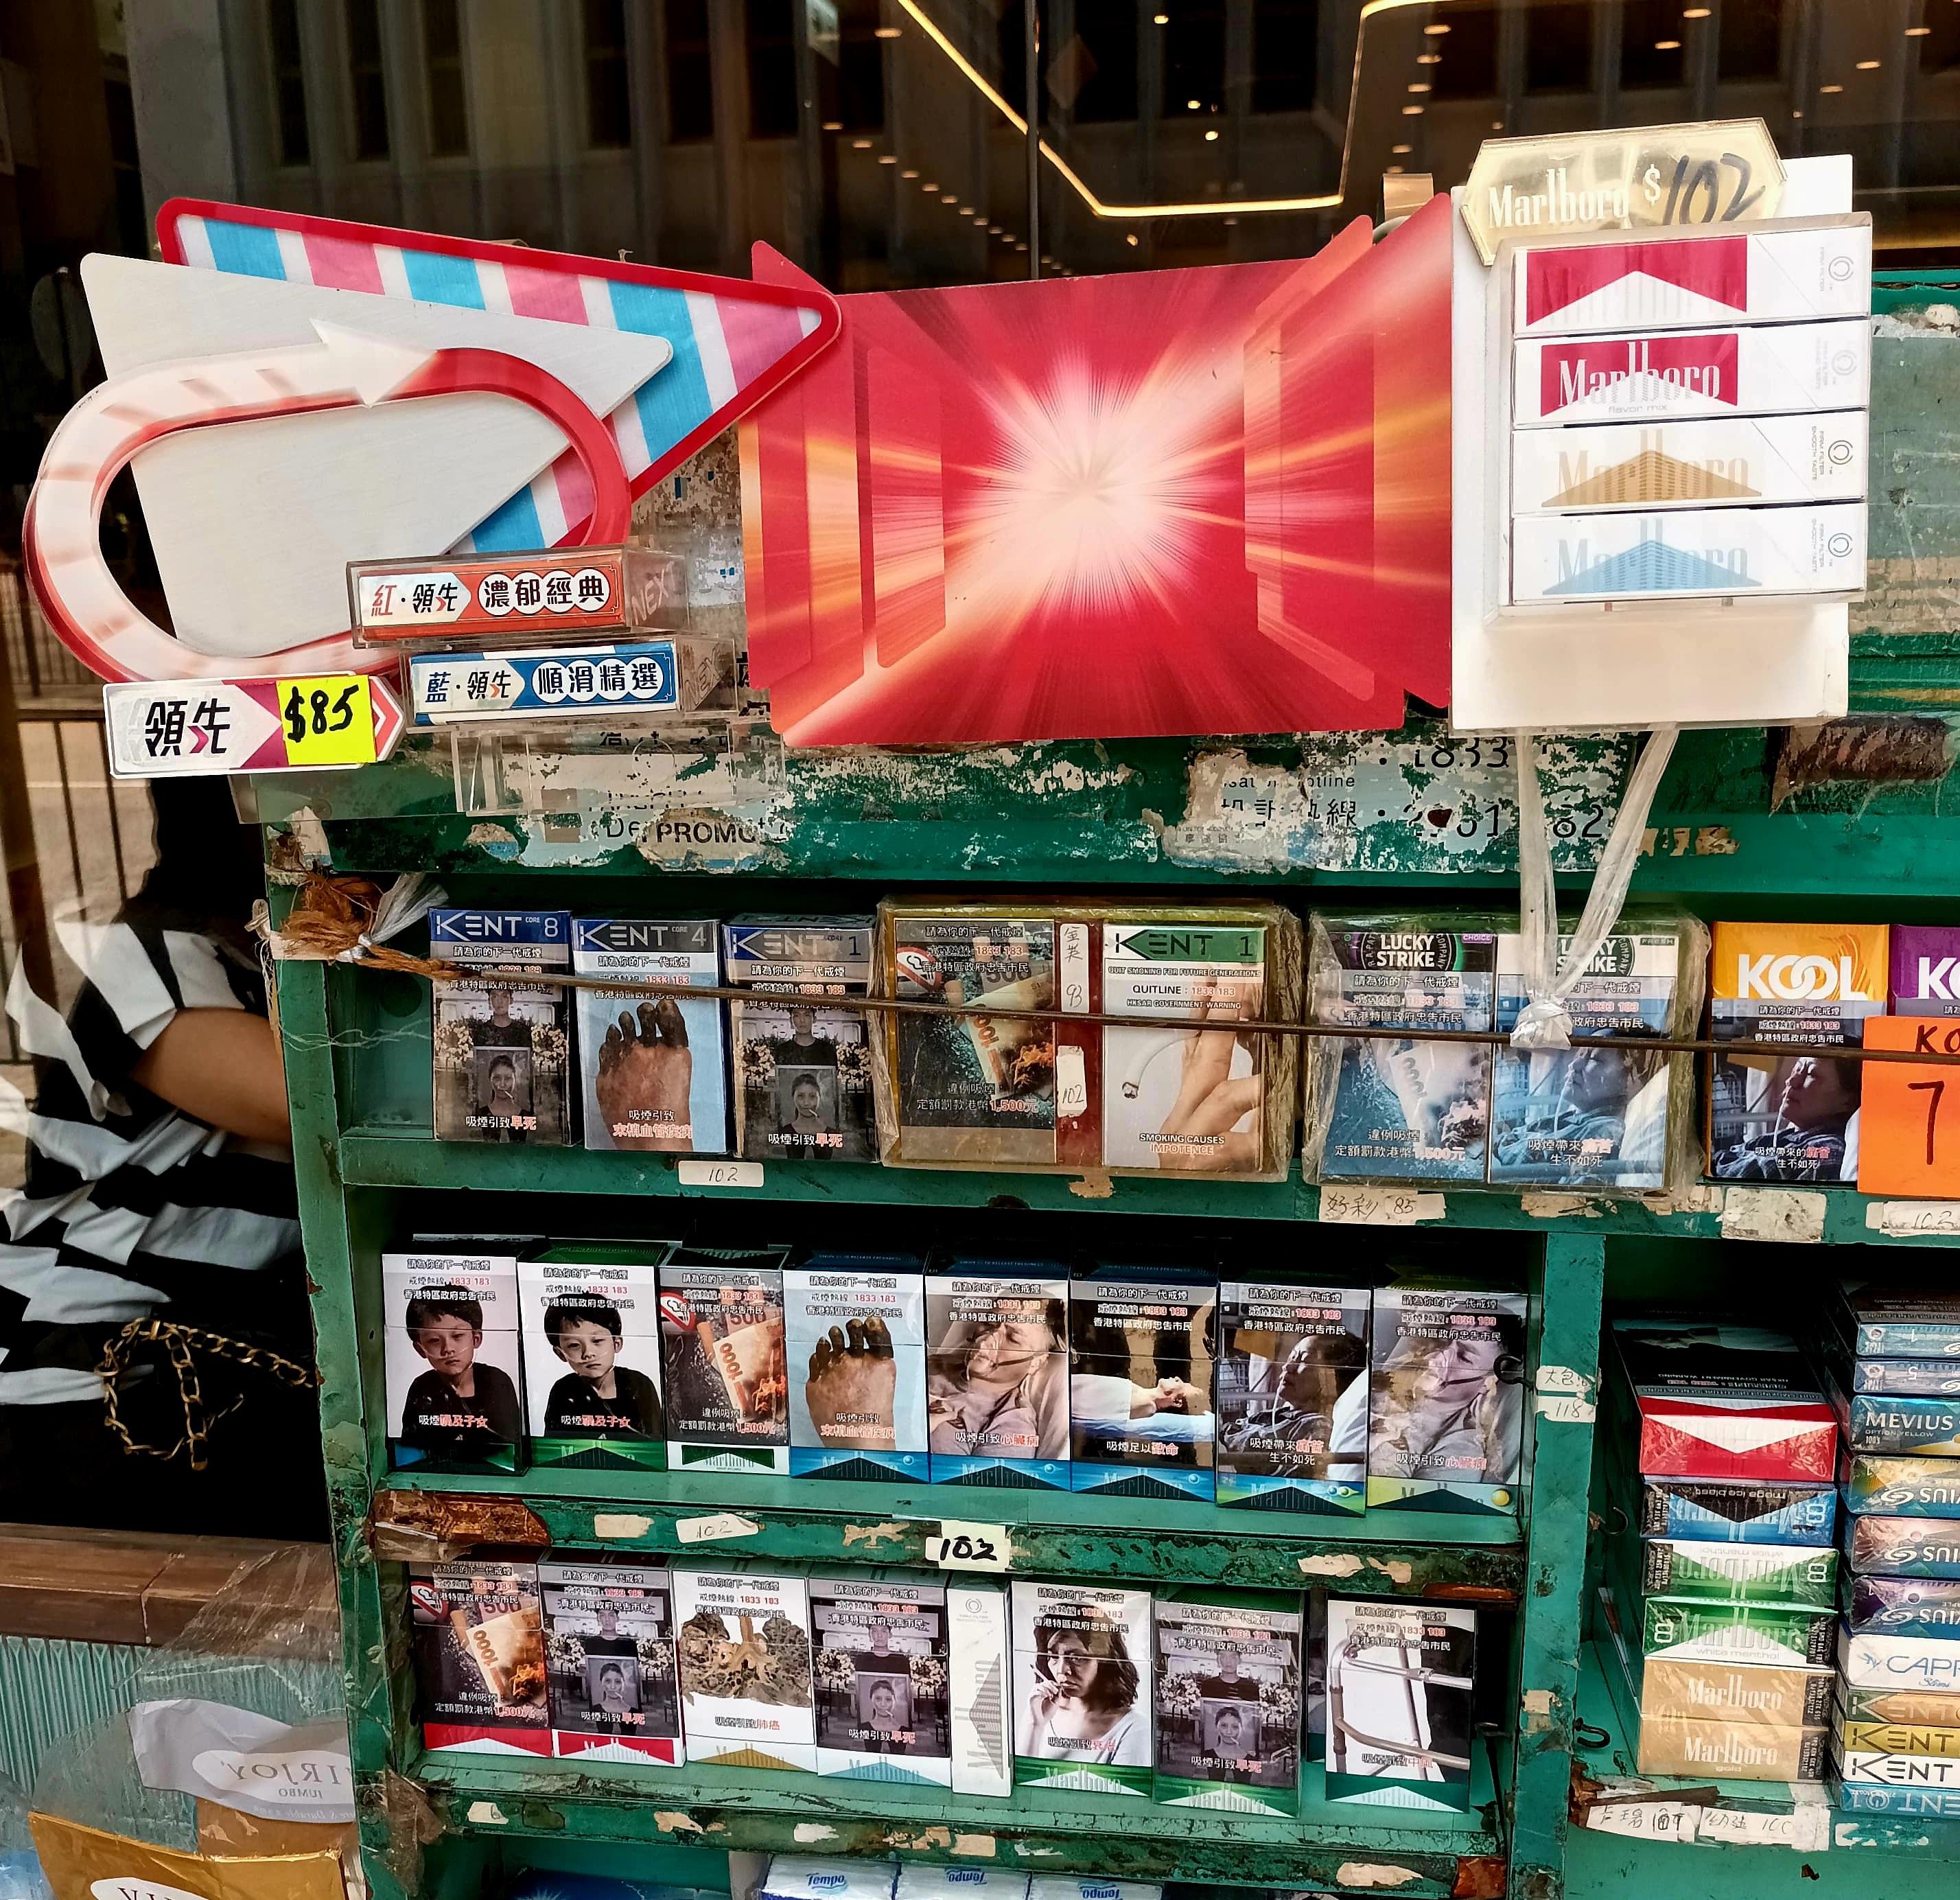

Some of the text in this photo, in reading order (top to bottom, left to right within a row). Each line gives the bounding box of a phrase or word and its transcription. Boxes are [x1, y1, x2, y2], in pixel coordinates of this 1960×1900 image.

[1489, 167, 1629, 229] Marlboro
[1559, 341, 1721, 406] Marlboro
[1644, 402, 1668, 412] mix
[483, 574, 607, 607] 濃郁經典
[537, 656, 660, 694] 順滑精選
[284, 685, 359, 743] $85
[144, 697, 231, 757] 領先
[436, 912, 522, 942] KENT
[544, 917, 559, 938] 8
[925, 925, 1024, 938] 請為你的下一代戒煙
[580, 923, 668, 951] KENT
[691, 927, 707, 946] 4
[1380, 934, 1434, 951] LUCKY
[1462, 934, 1492, 942] CHOICE
[453, 946, 542, 959] 請為你的下一代戒煙
[733, 930, 862, 960] KENT 1
[1115, 929, 1254, 961] KENT 1
[598, 955, 690, 968] 請為你的下一代戒煙
[921, 961, 1029, 973] 香港特區政府忠告市民
[1376, 951, 1436, 968] STRIKE
[751, 964, 845, 977] 請為你的下一代戒煙
[1108, 966, 1127, 975] QUIT
[1128, 966, 1163, 975] SMOKING
[1180, 968, 1209, 977] FUTURE
[1209, 969, 1261, 977] GENERATIONS
[1738, 953, 1869, 1001] KOOL
[1354, 975, 1460, 988] 請為你的下一代戒煙
[800, 985, 845, 995] 1833 183
[1132, 984, 1235, 996] QUITLINE 1833 183
[1153, 999, 1204, 1009] GOVERNMENT
[1206, 1001, 1241, 1010] WARNING
[1758, 1005, 1841, 1017] 請為你的下一代戒煙
[1346, 1010, 1463, 1024] 香港特區政府忠告市民
[1754, 1032, 1844, 1044] 香港特區政府忠告市民
[465, 1115, 537, 1131] 吸煙引致早死
[1907, 1080, 1945, 1166] 7
[768, 1133, 843, 1148] 吸煙引致早死
[1139, 1133, 1225, 1145] SMOKING CAUSES
[1150, 1144, 1214, 1155] IMPOTENCE
[1550, 1154, 1603, 1168] 生不如死
[1777, 1158, 1819, 1170] 生不如死
[708, 1167, 739, 1183] 102
[450, 1277, 490, 1286] 1833 183
[952, 1281, 1042, 1295] 請為你的下一代戒煙
[587, 1284, 628, 1295] 1833 183
[1098, 1286, 1189, 1301] 請為你的下一代戒煙
[1248, 1288, 1342, 1304] 請為你的下一代戒煙
[854, 1293, 896, 1304] 1833 183
[1401, 1295, 1498, 1310] 請為你的下一代戒煙
[679, 1303, 764, 1315] 香港特區政府忠告市民
[1296, 1307, 1342, 1320] 1833 183
[948, 1311, 1047, 1325] 香港特區政府忠告市民
[1093, 1317, 1193, 1332] 香港特區政府忠告市民
[1243, 1319, 1346, 1336] 香港特區政府忠告市民
[1395, 1325, 1502, 1342] 香港特區政府忠告市民
[1556, 1399, 1584, 1418] 118
[1865, 1411, 1953, 1431] MEVIUS
[1269, 1451, 1316, 1465] 生不如死
[939, 1536, 998, 1562] 102
[1687, 1674, 1783, 1711] Marlboro
[1852, 1693, 1956, 1723] KENT
[1852, 1724, 1955, 1754] KENT
[1683, 1733, 1779, 1765] Marlboro
[1851, 1754, 1954, 1783] KENT
[806, 1872, 847, 1890] Tempo
[946, 1868, 986, 1886] Tempo
